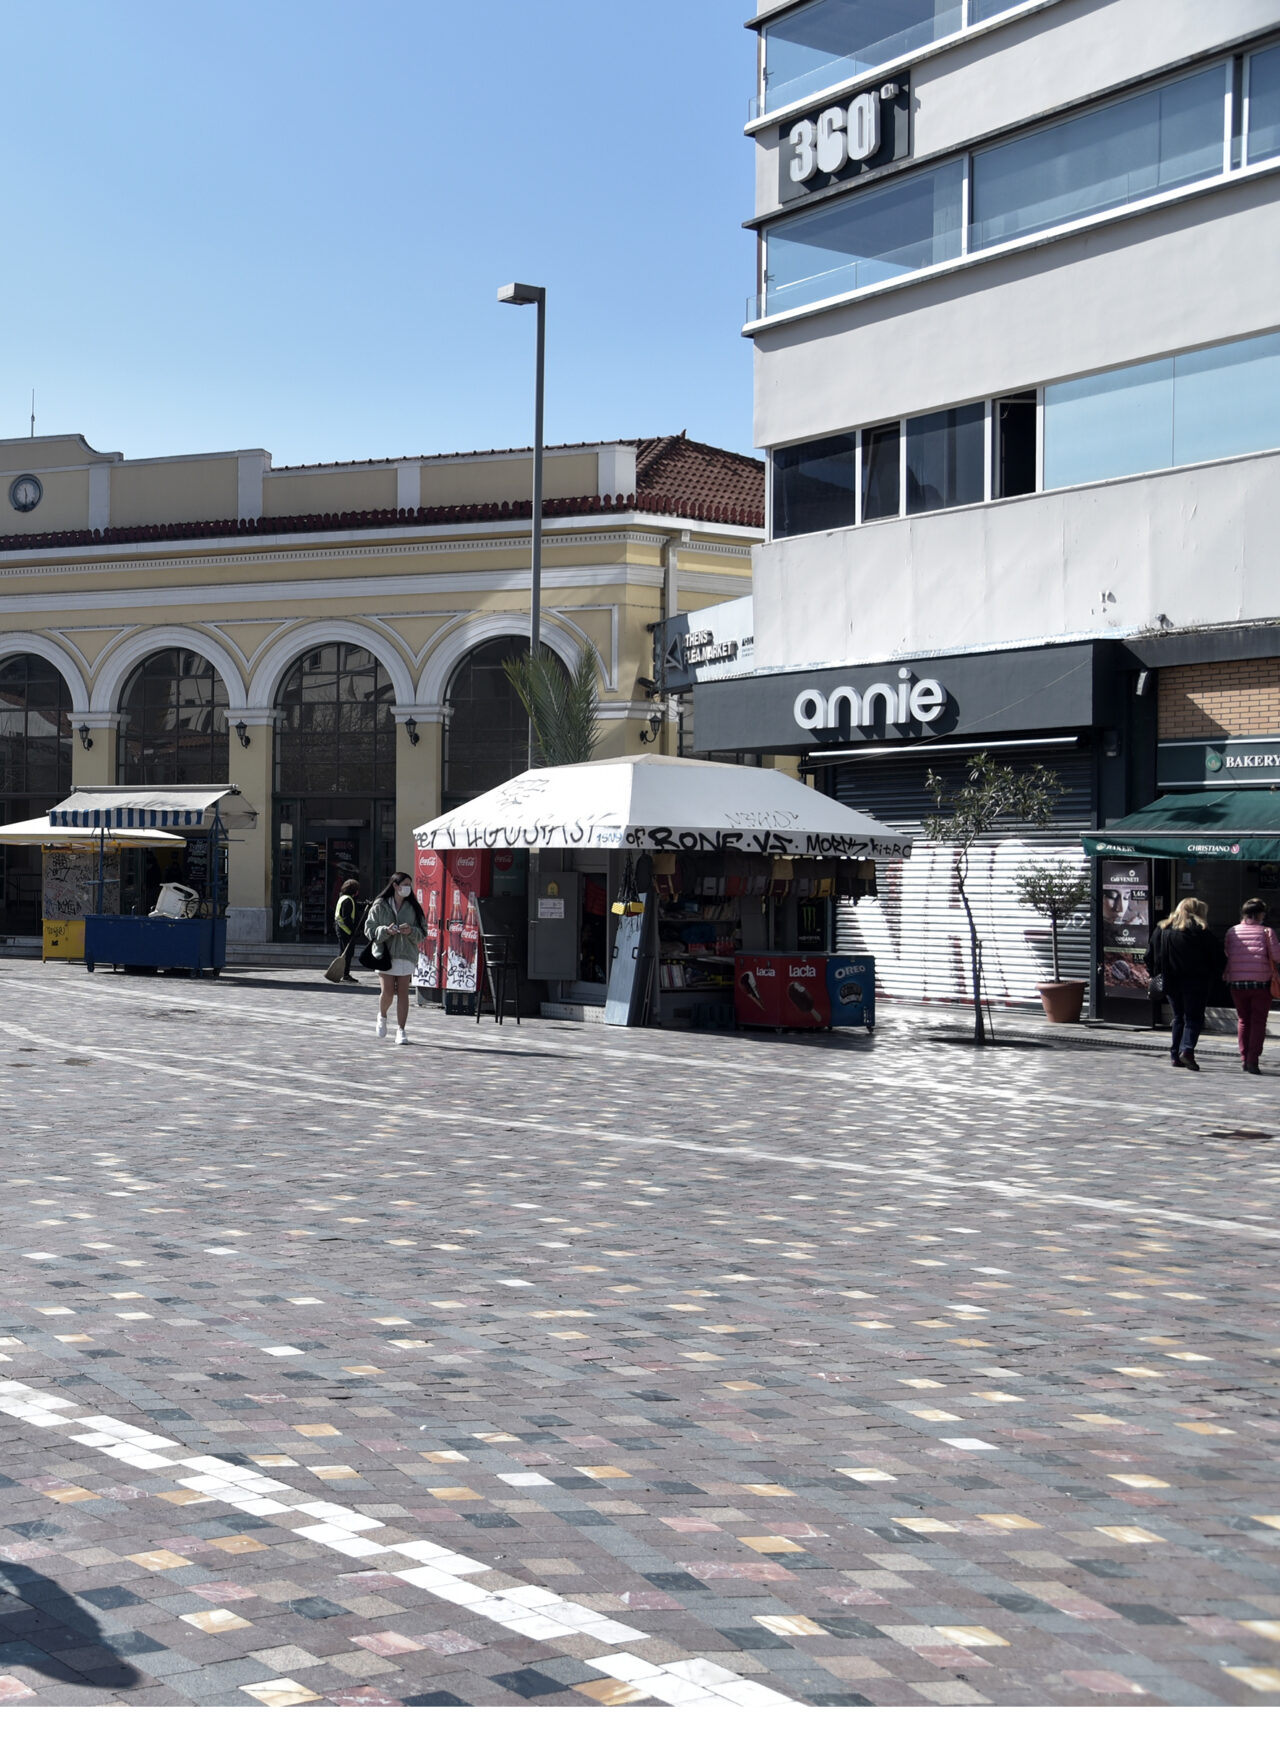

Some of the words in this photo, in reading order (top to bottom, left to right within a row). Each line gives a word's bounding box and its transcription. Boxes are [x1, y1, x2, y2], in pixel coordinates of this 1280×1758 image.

[794, 667, 946, 730] annie
[1225, 754, 1280, 768] BAKERY
[789, 965, 816, 977] Lacta
[835, 965, 866, 979] OREO
